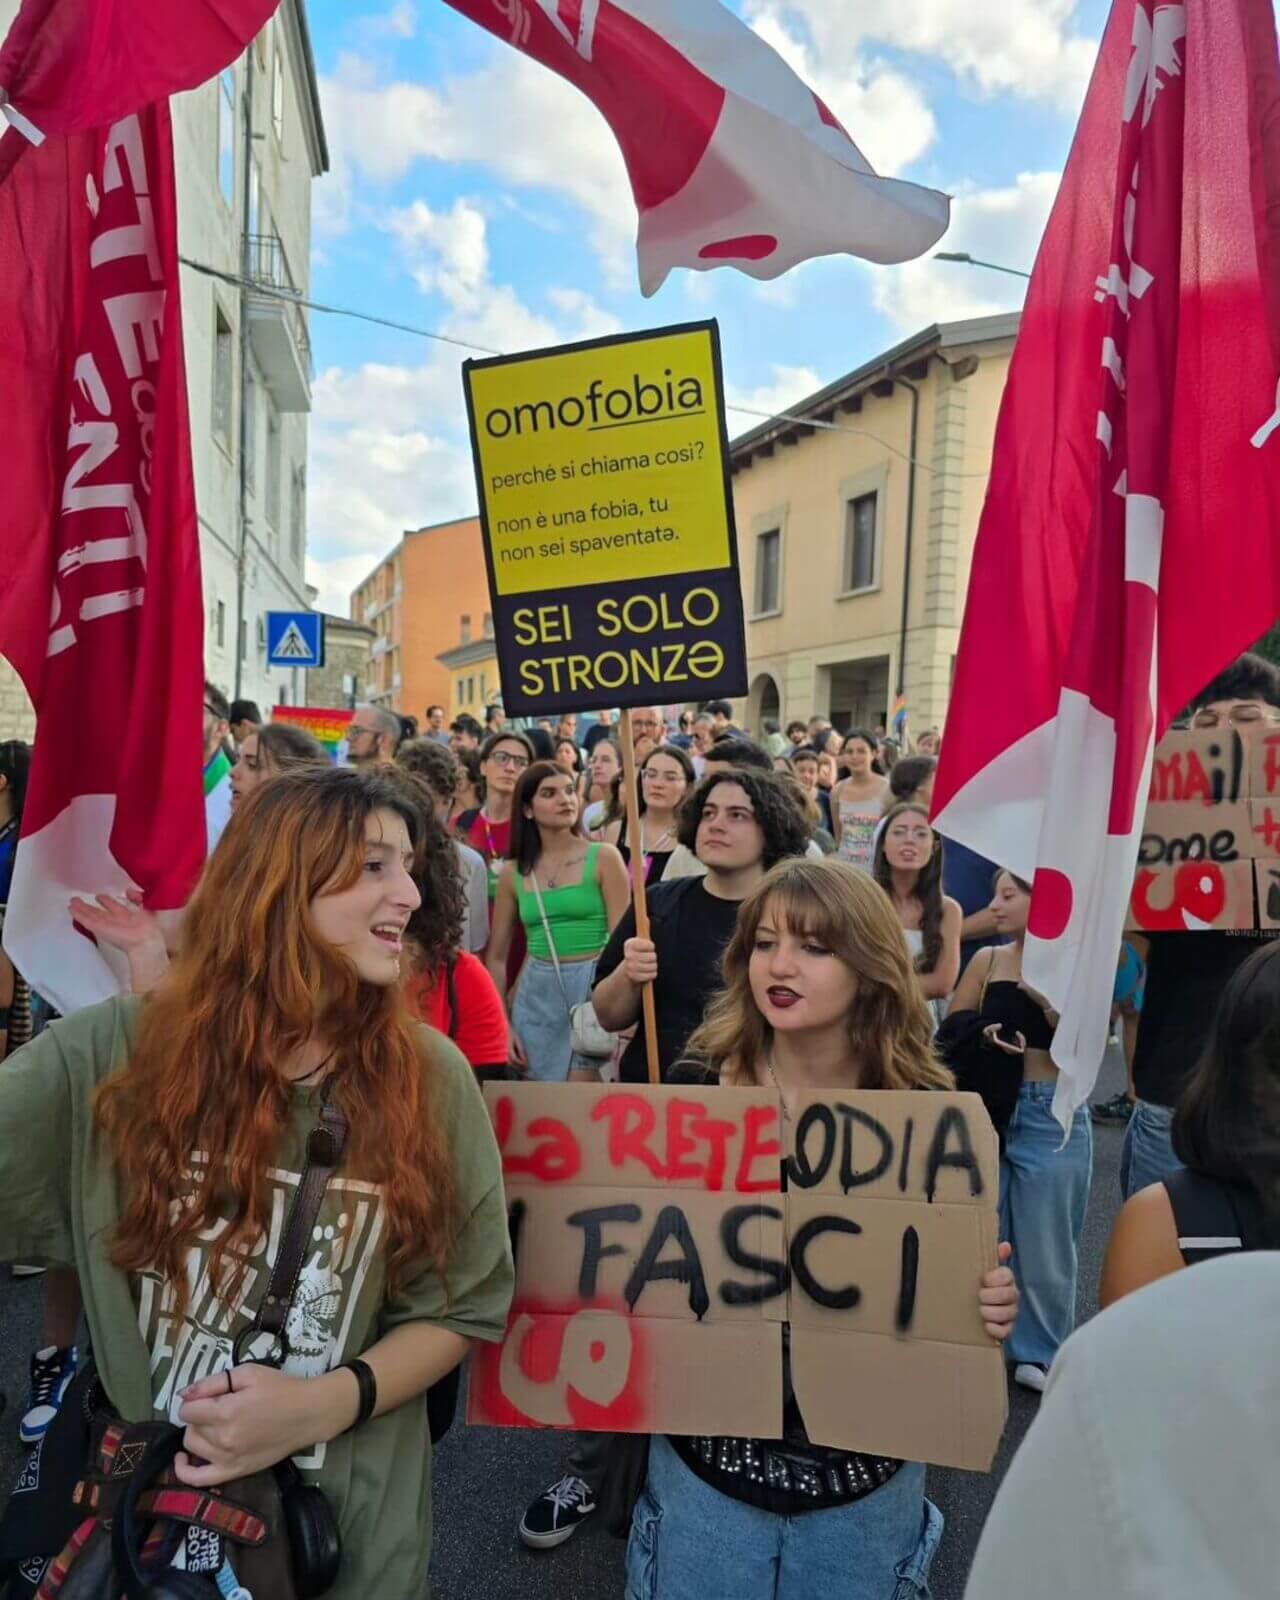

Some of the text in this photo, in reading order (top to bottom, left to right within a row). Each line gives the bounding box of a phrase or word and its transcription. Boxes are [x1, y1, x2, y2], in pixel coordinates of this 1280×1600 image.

[485, 369, 703, 438] omofobia
[491, 463, 556, 494] perché
[561, 460, 576, 480] si
[580, 455, 650, 477] chiama
[497, 496, 668, 534] non è una fobia, tu
[501, 547, 535, 562] non
[539, 540, 565, 557] sei
[513, 587, 720, 646] SEI SOLO
[495, 1092, 983, 1204] La RETE ODIA
[567, 1203, 920, 1335] FASCI
[208, 1531, 220, 1568] ORN
